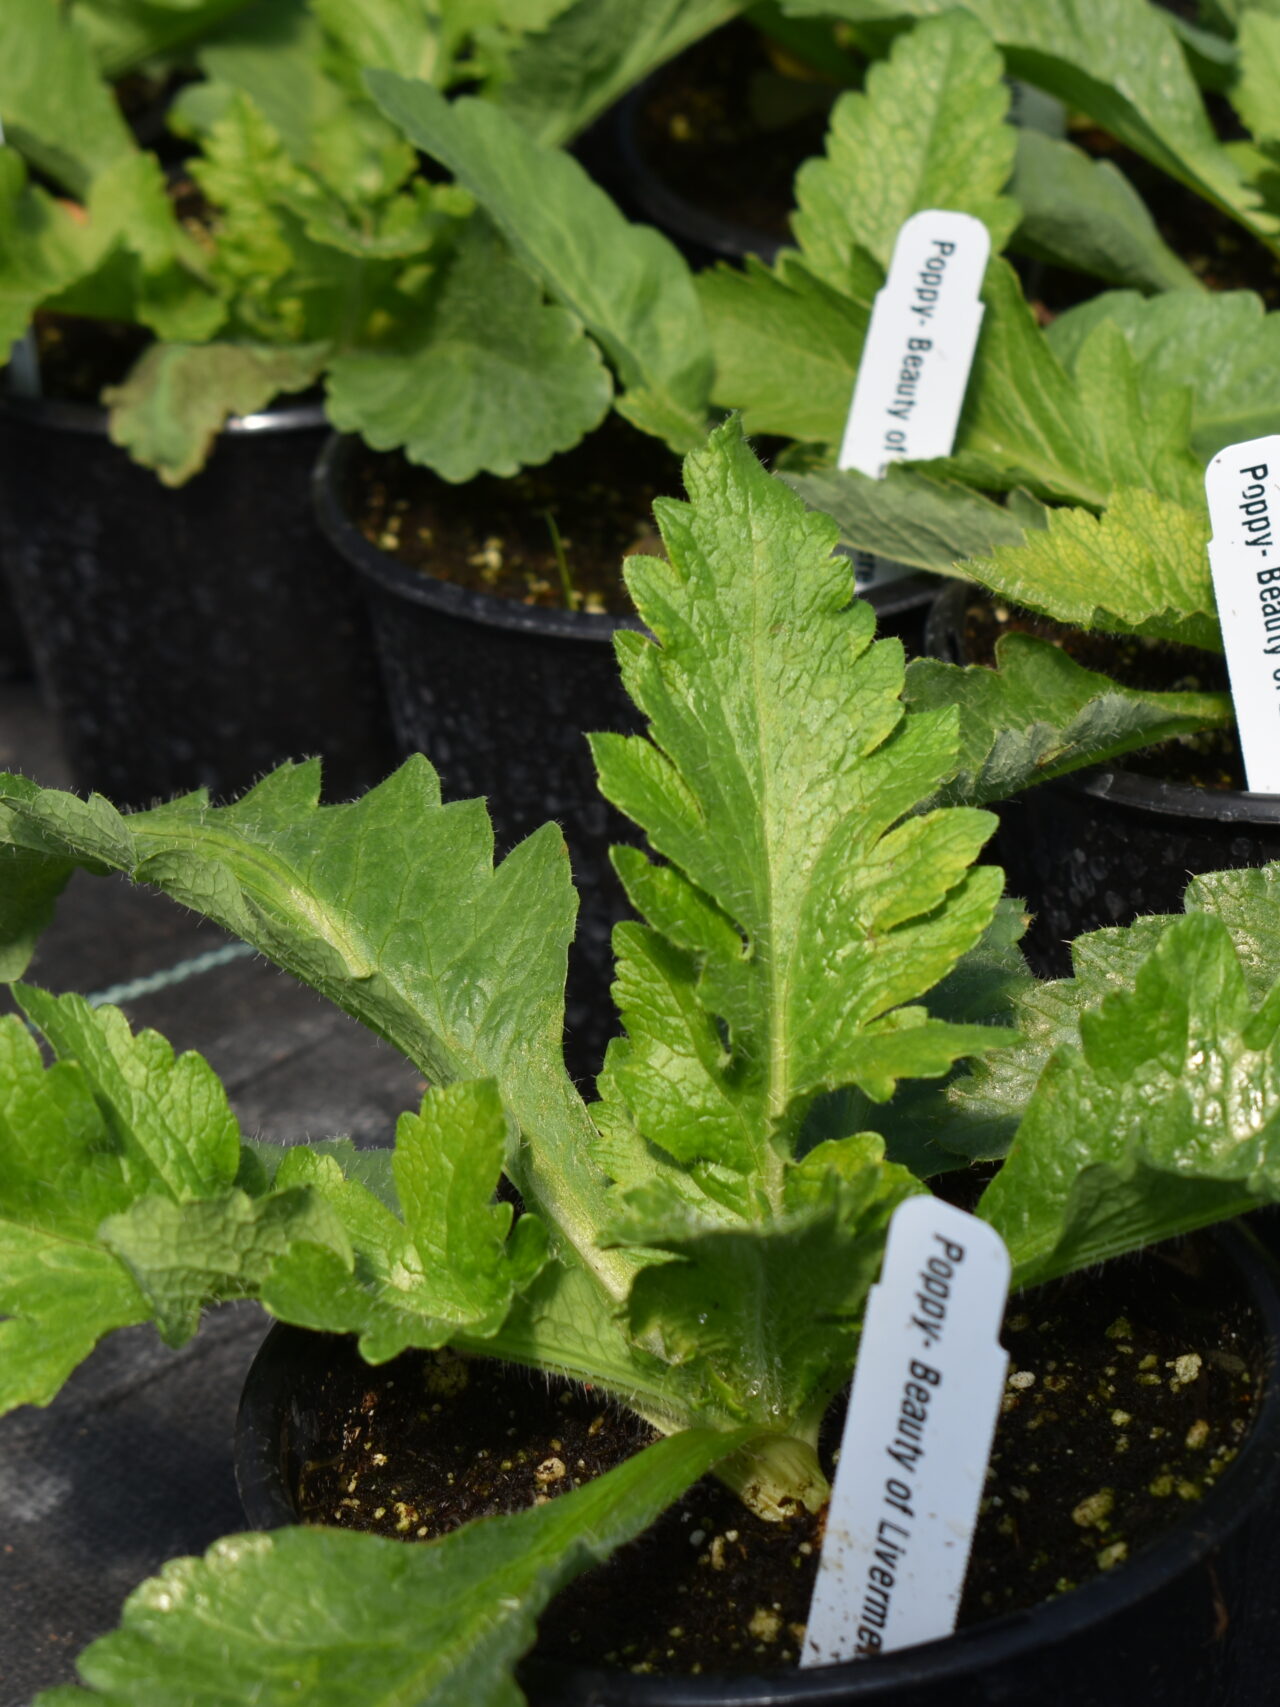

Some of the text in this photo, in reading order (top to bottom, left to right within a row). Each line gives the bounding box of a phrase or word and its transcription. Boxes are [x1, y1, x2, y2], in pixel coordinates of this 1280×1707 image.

[884, 239, 956, 453] Poppy- Beauty of
[1239, 463, 1274, 556] Poppy-
[911, 1233, 965, 1348] Poppy-
[885, 1358, 942, 1474] Beauty
[883, 1479, 915, 1517] of
